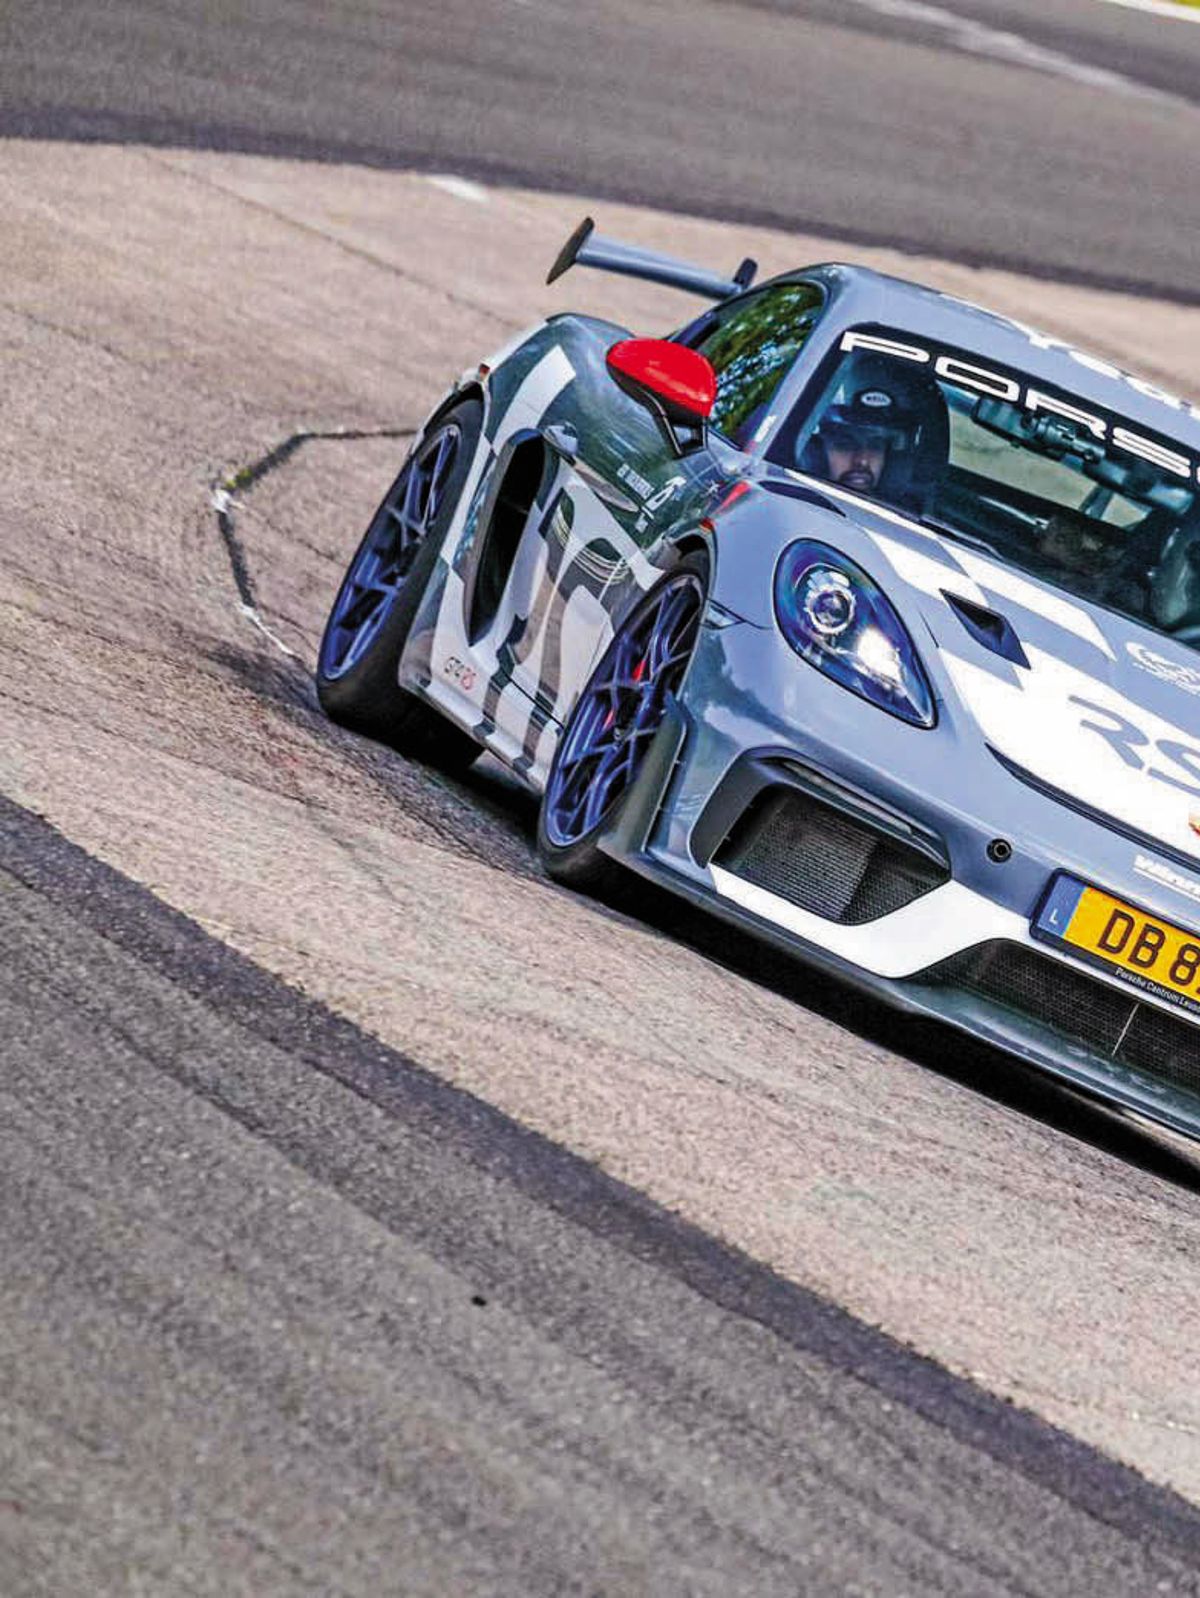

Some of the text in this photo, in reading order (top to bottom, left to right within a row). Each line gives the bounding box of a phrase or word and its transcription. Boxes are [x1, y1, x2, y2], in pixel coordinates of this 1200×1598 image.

[1048, 909, 1060, 926] L
[1096, 908, 1166, 969] DB
[1115, 967, 1146, 987] Porsche
